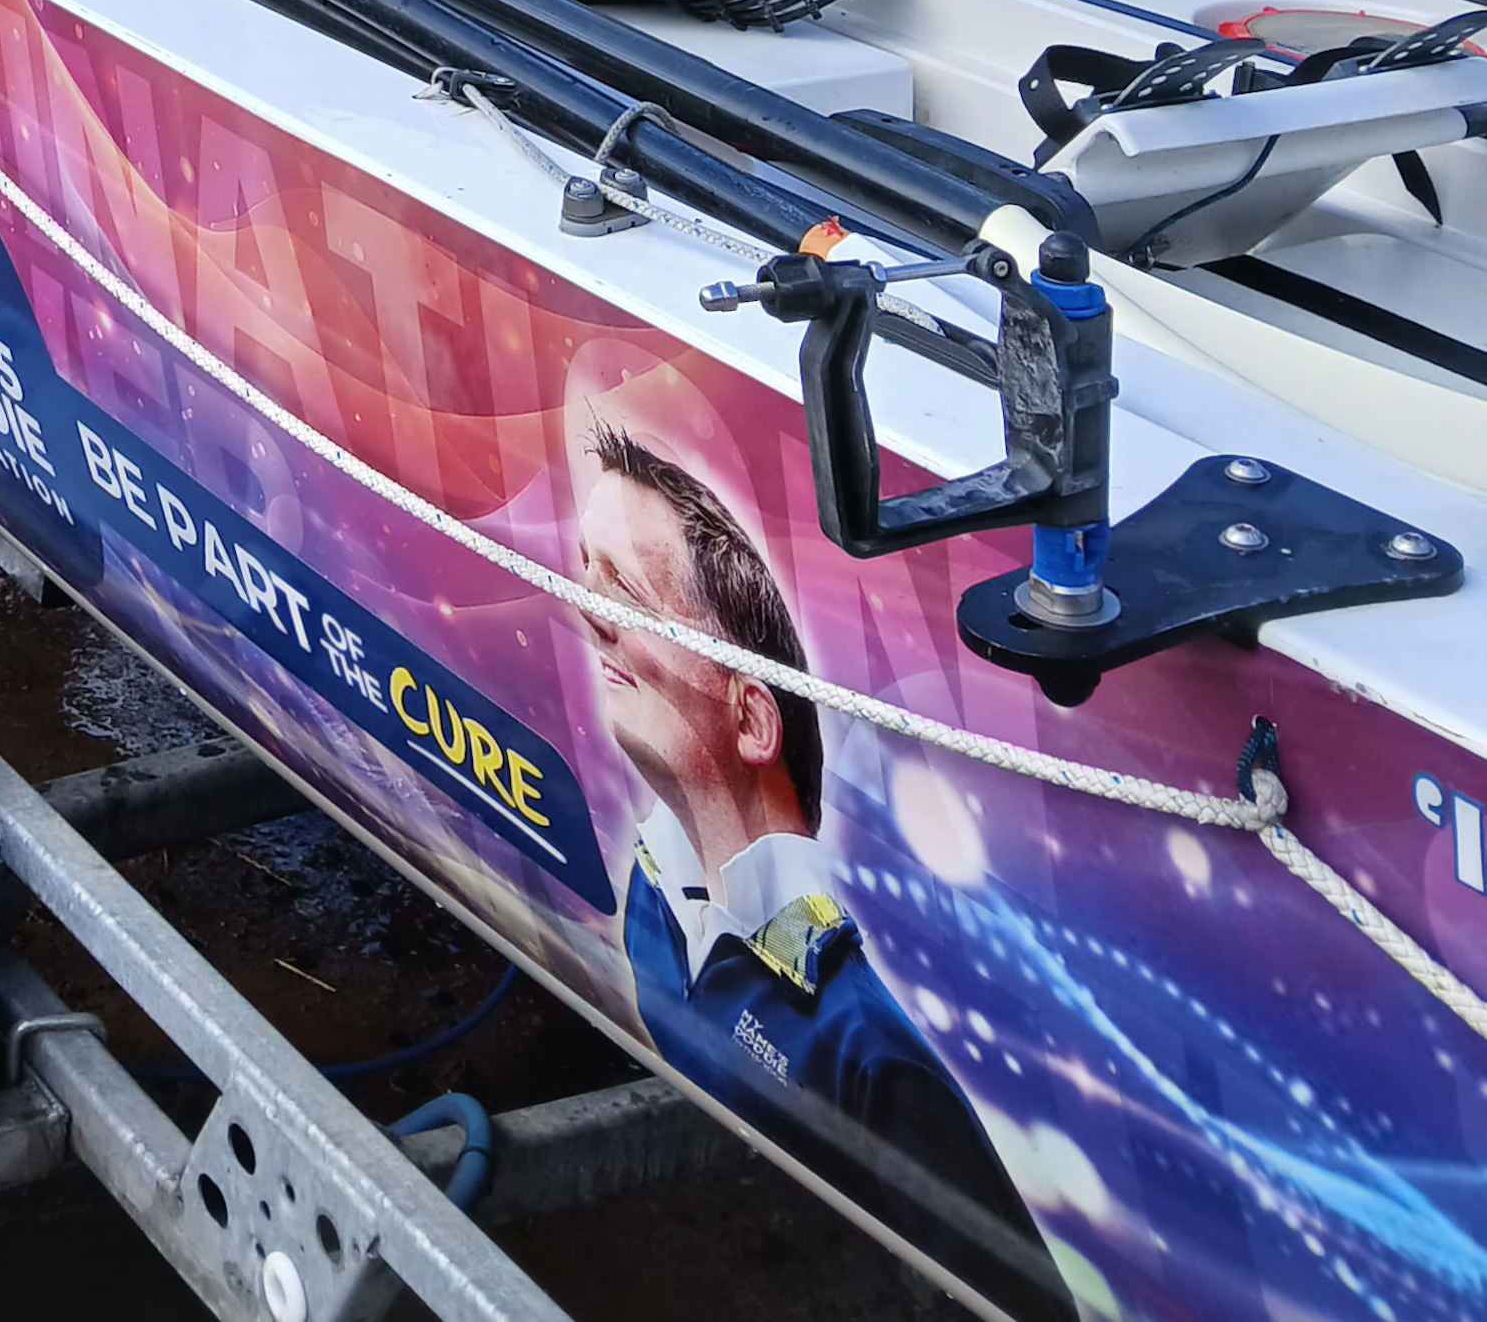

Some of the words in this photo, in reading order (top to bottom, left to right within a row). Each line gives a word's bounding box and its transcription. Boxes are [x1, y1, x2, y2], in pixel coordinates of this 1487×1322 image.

[75, 418, 158, 531] BE
[155, 481, 312, 654] PART
[319, 637, 389, 715] THE
[322, 611, 366, 662] OF
[388, 665, 551, 828] CURE
